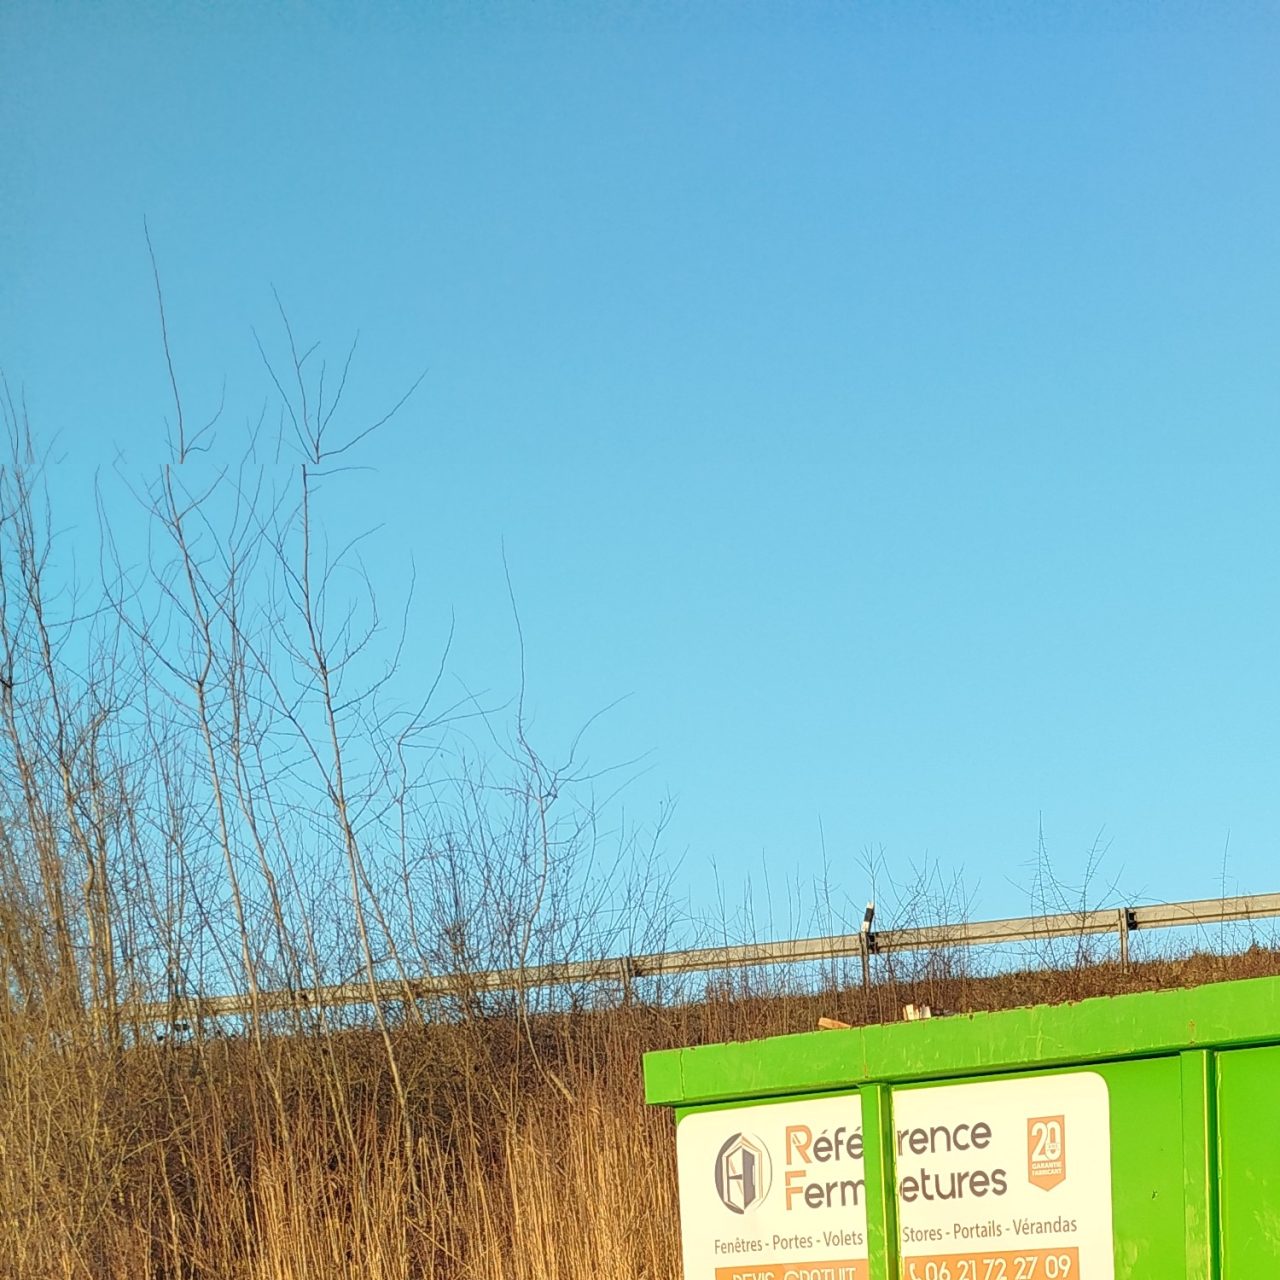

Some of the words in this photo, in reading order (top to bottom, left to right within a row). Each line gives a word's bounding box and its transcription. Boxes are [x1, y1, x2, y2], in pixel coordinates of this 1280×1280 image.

[785, 1121, 992, 1165] Référence
[1031, 1120, 1061, 1162] 20
[785, 1168, 1008, 1211] Fermetures
[714, 1237, 763, 1254] Fenêtres
[773, 1234, 813, 1250] Portes
[823, 1229, 864, 1247] Volets
[902, 1226, 943, 1243] Stores
[953, 1220, 1002, 1239] Portails
[1012, 1215, 1078, 1236] Vérandas
[1014, 1256, 1038, 1280] 27
[1045, 1254, 1071, 1279] 09
